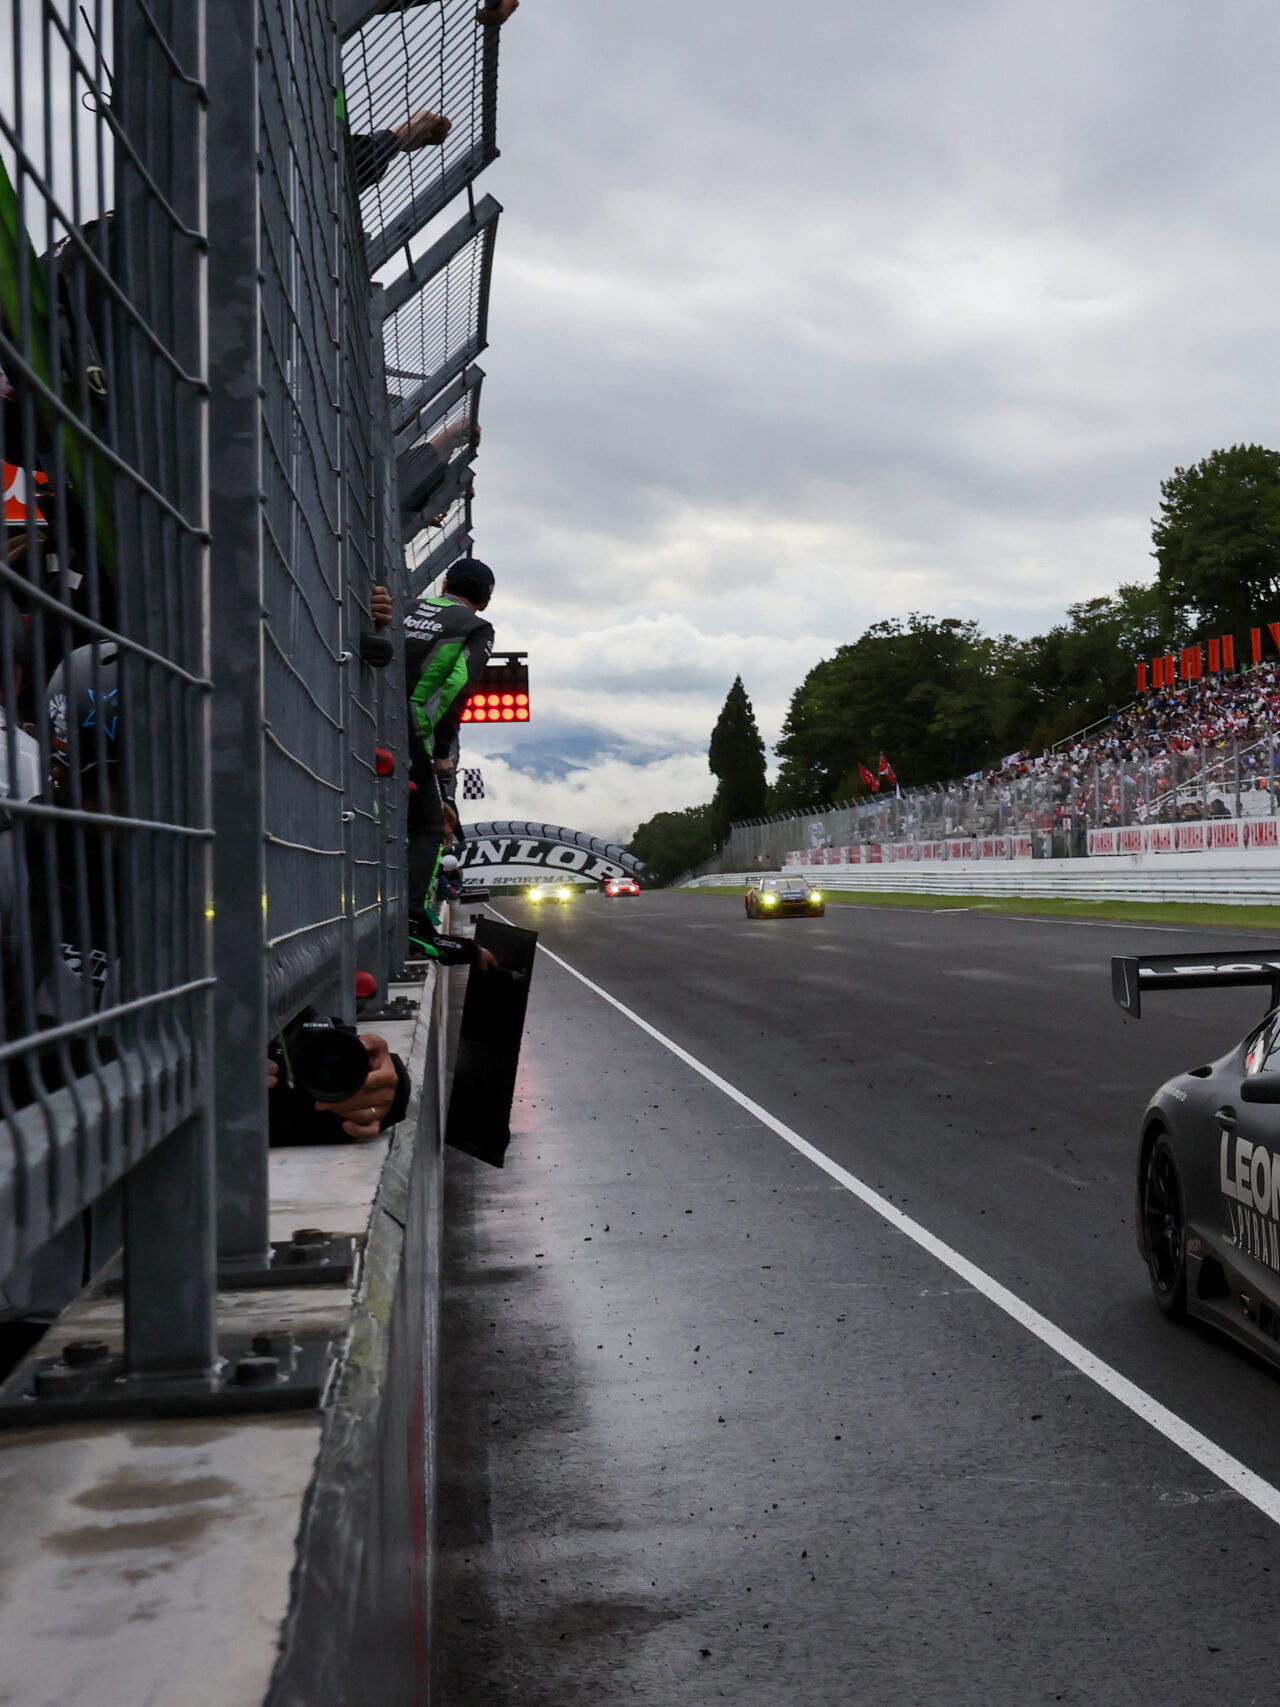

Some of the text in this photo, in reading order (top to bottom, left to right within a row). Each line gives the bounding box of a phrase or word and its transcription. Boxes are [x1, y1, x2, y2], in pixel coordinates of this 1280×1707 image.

[403, 615, 443, 632] loitte.
[1214, 824, 1239, 848] YAMAHA
[1250, 821, 1278, 847] YAMAHA
[452, 839, 624, 881] UNLOP
[492, 875, 577, 884] SPORTMAX
